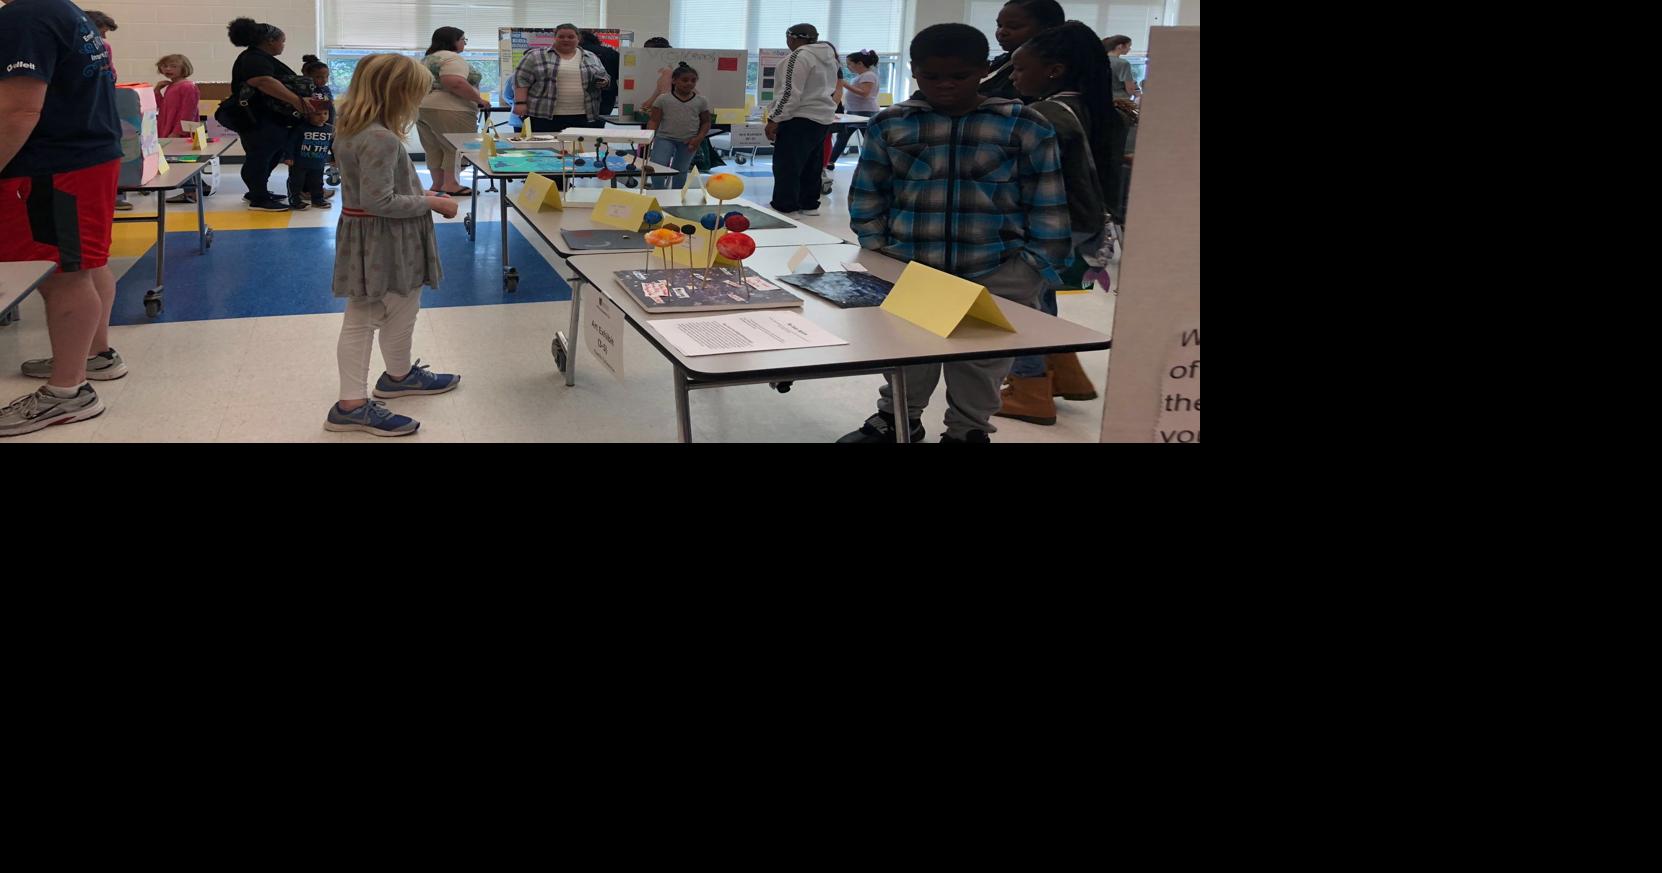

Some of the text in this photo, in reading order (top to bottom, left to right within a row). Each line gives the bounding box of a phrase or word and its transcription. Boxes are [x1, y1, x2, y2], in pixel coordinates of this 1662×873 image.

[303, 131, 333, 141] BEST
[301, 144, 311, 152] IN
[1169, 359, 1200, 379] of
[1160, 429, 1200, 443] yo
